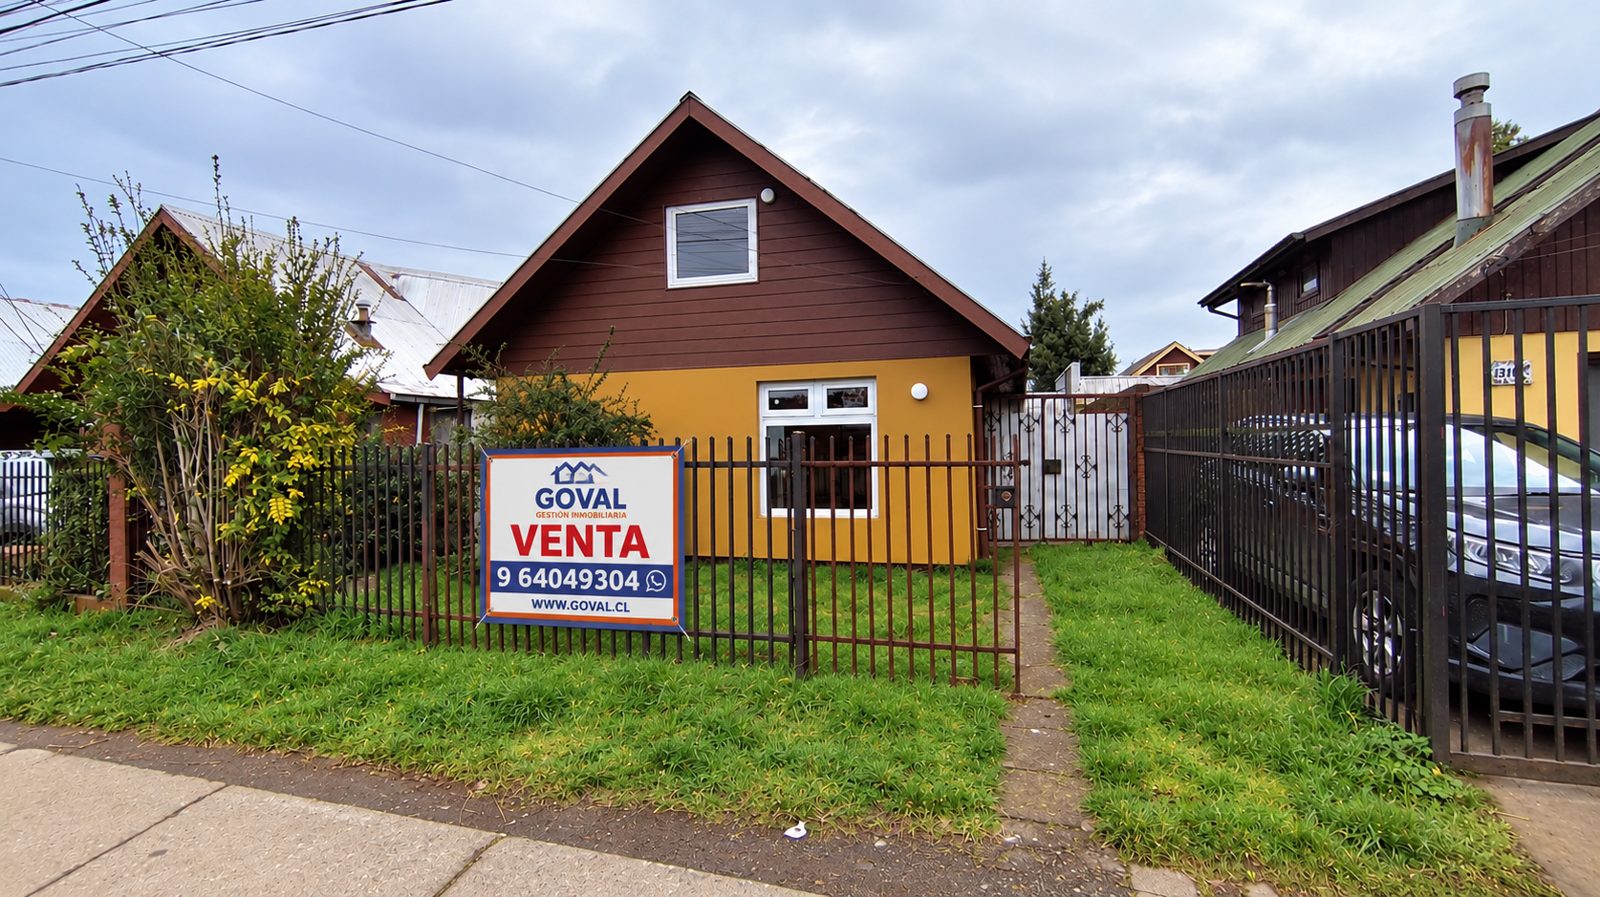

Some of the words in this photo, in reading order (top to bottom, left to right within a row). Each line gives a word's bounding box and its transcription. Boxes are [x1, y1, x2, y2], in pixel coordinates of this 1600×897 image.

[1494, 367, 1519, 378] 131
[535, 487, 626, 510] GOVAL
[510, 524, 650, 559] VENTA
[497, 566, 511, 587] 9
[518, 567, 640, 591] 64049304
[531, 598, 630, 613] WWW.GOVAL.CL
